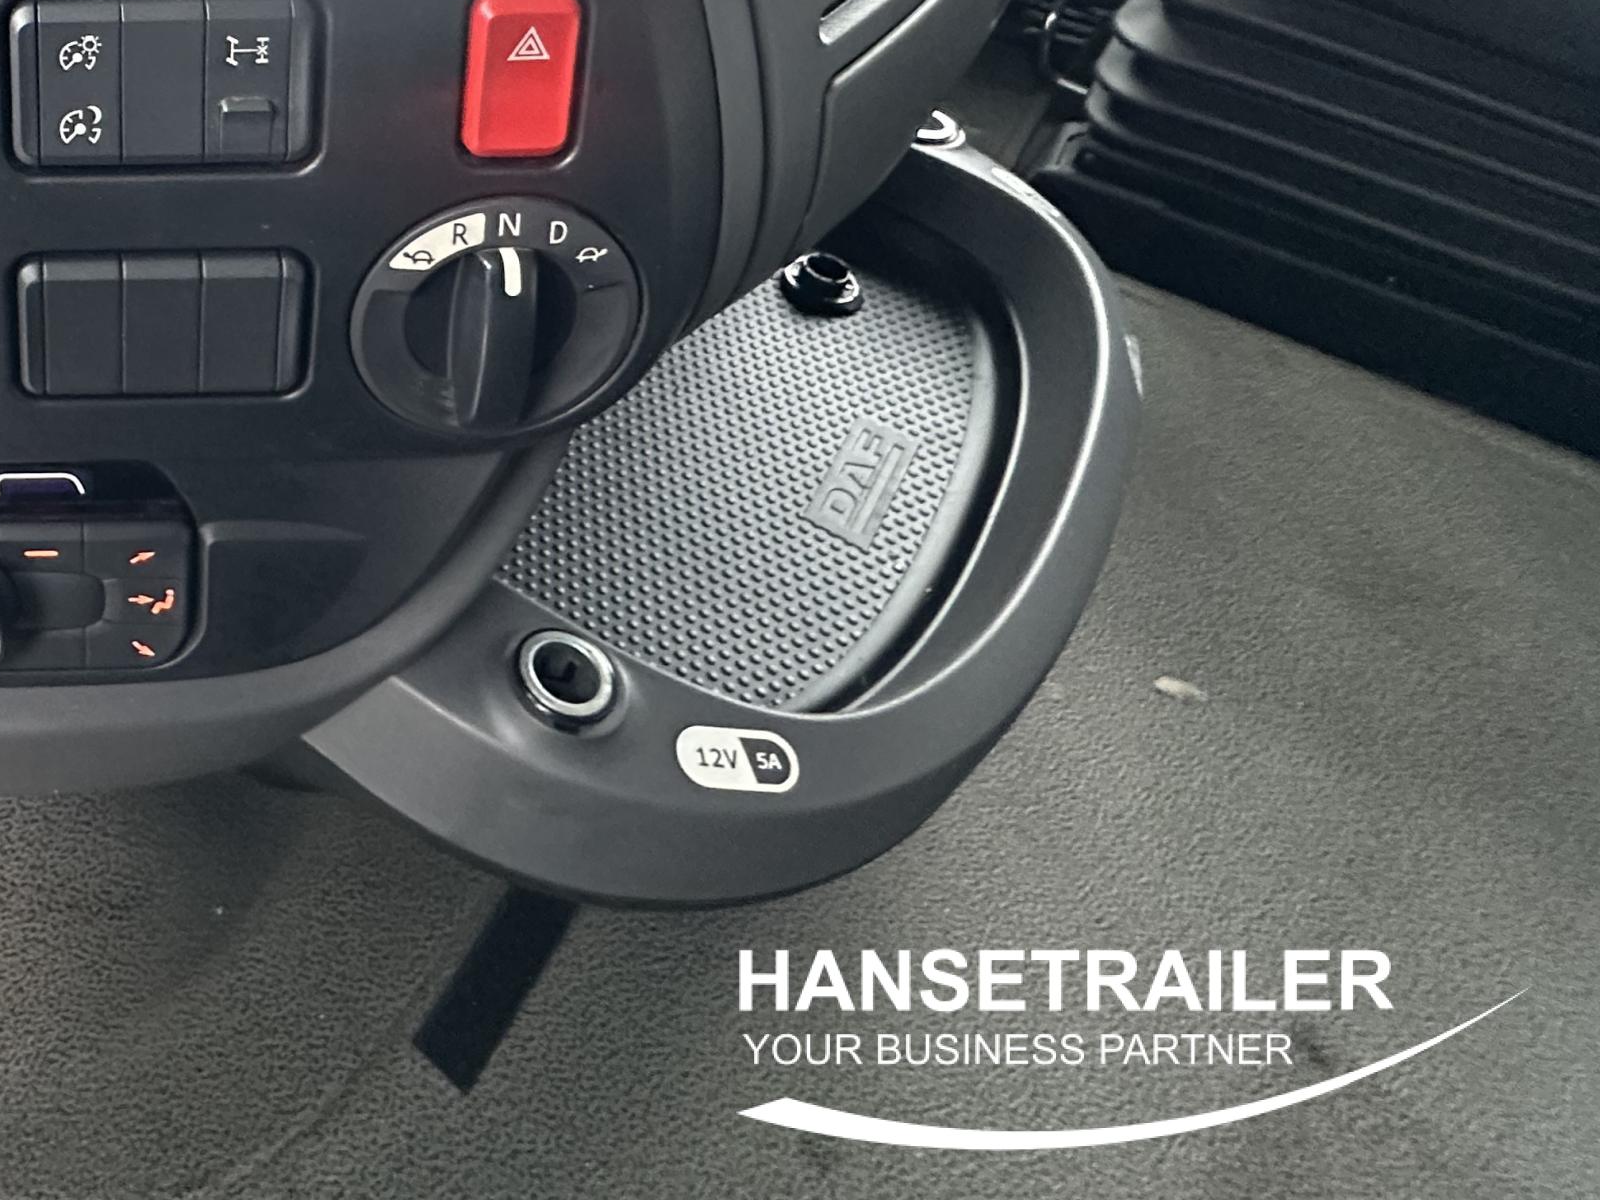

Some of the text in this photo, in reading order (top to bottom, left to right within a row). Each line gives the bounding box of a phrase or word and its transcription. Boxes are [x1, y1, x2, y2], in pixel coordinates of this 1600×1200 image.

[453, 213, 568, 245] R N D
[819, 427, 883, 528] DAF
[696, 747, 783, 770] 12V 5A
